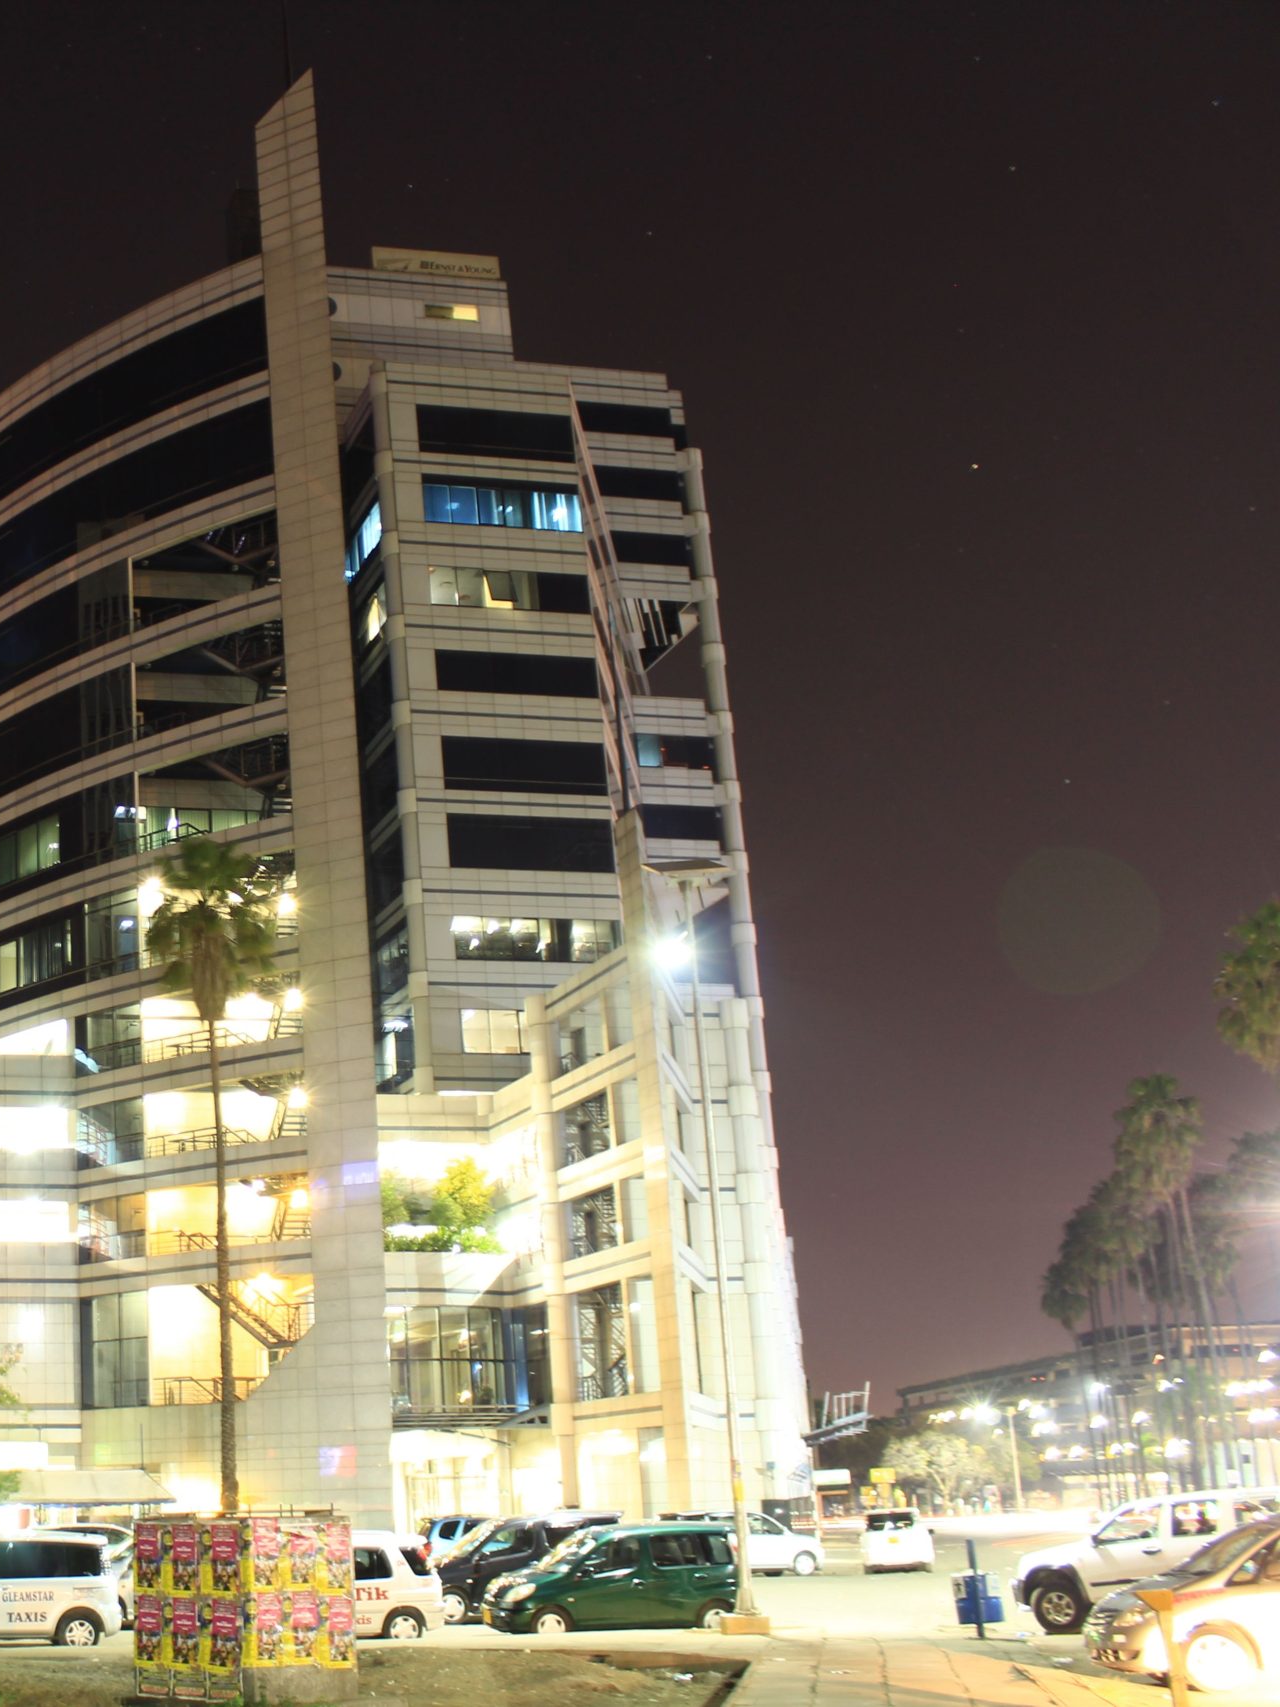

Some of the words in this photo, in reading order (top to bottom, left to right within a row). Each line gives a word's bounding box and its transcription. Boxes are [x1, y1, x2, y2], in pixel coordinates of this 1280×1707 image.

[430, 260, 457, 272] ERNST
[464, 264, 497, 275] YOUNG
[2, 1591, 55, 1603] GLEAMSTAR
[7, 1611, 48, 1623] TAXIS
[354, 1615, 372, 1625] xis
